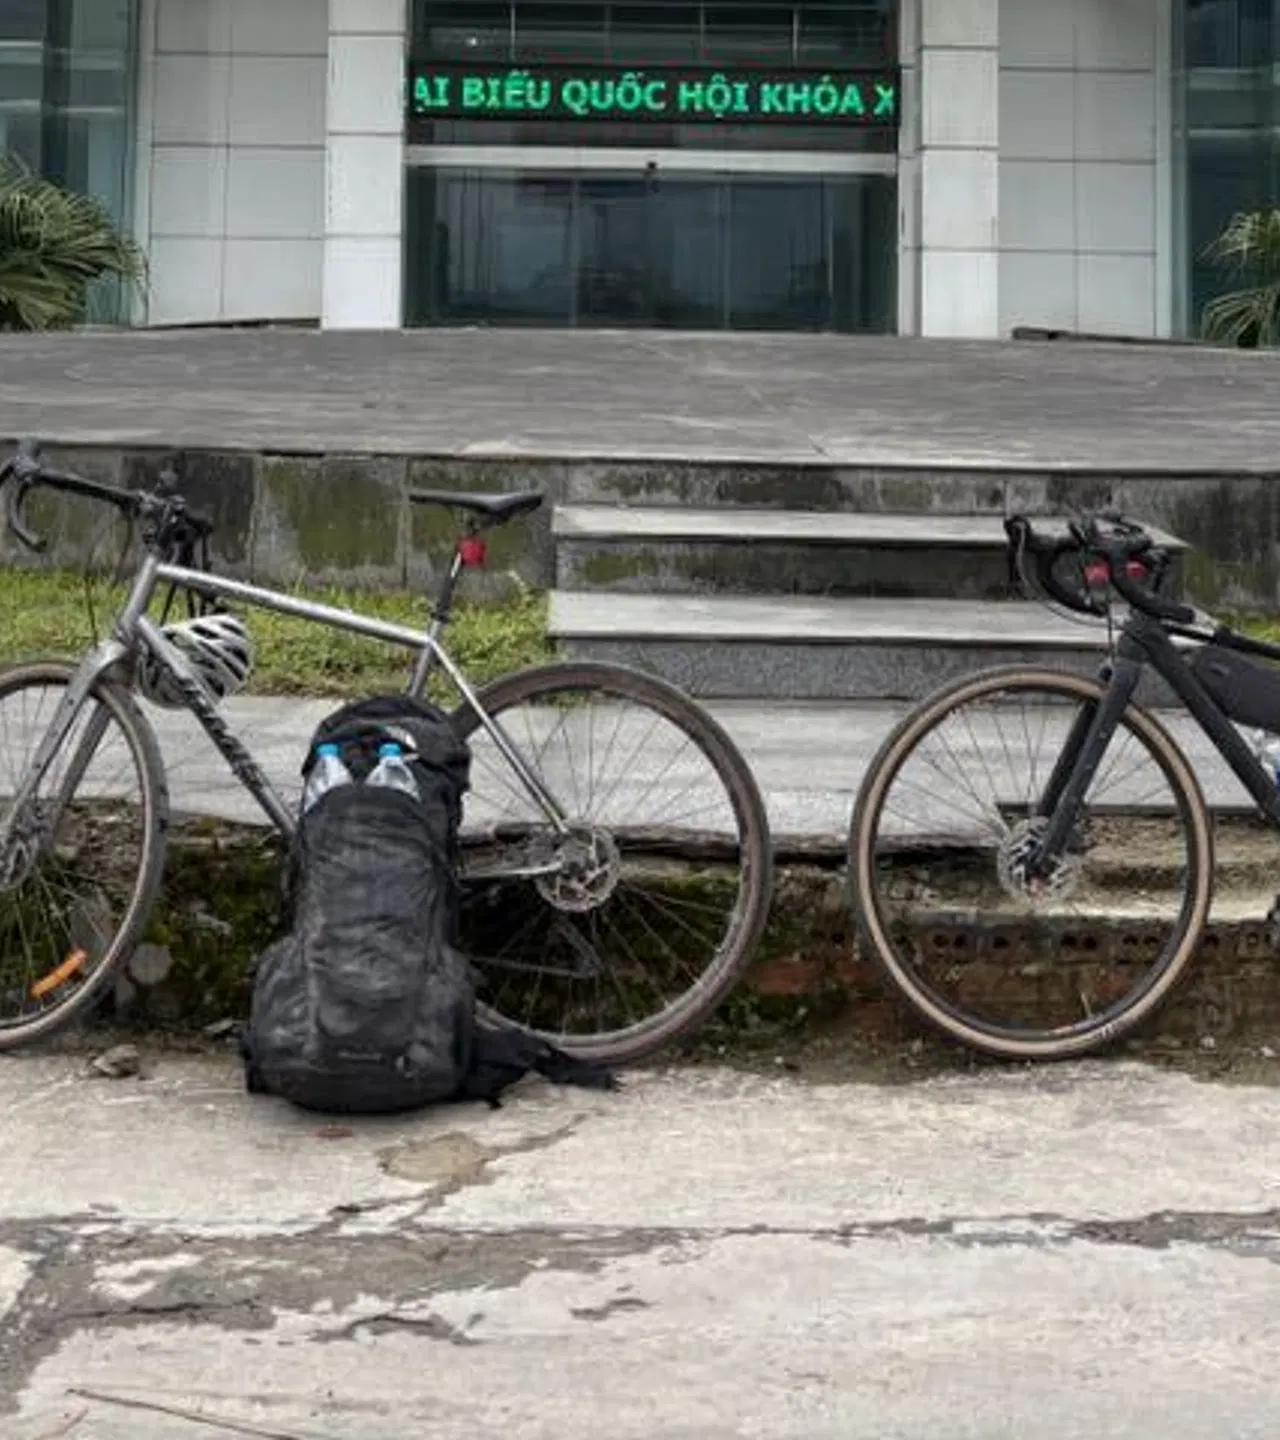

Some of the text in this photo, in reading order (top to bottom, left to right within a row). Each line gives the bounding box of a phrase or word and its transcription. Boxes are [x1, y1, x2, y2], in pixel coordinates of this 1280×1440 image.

[561, 72, 666, 115] QUỐC
[679, 73, 749, 118] HỘI
[761, 75, 864, 114] KHÓA
